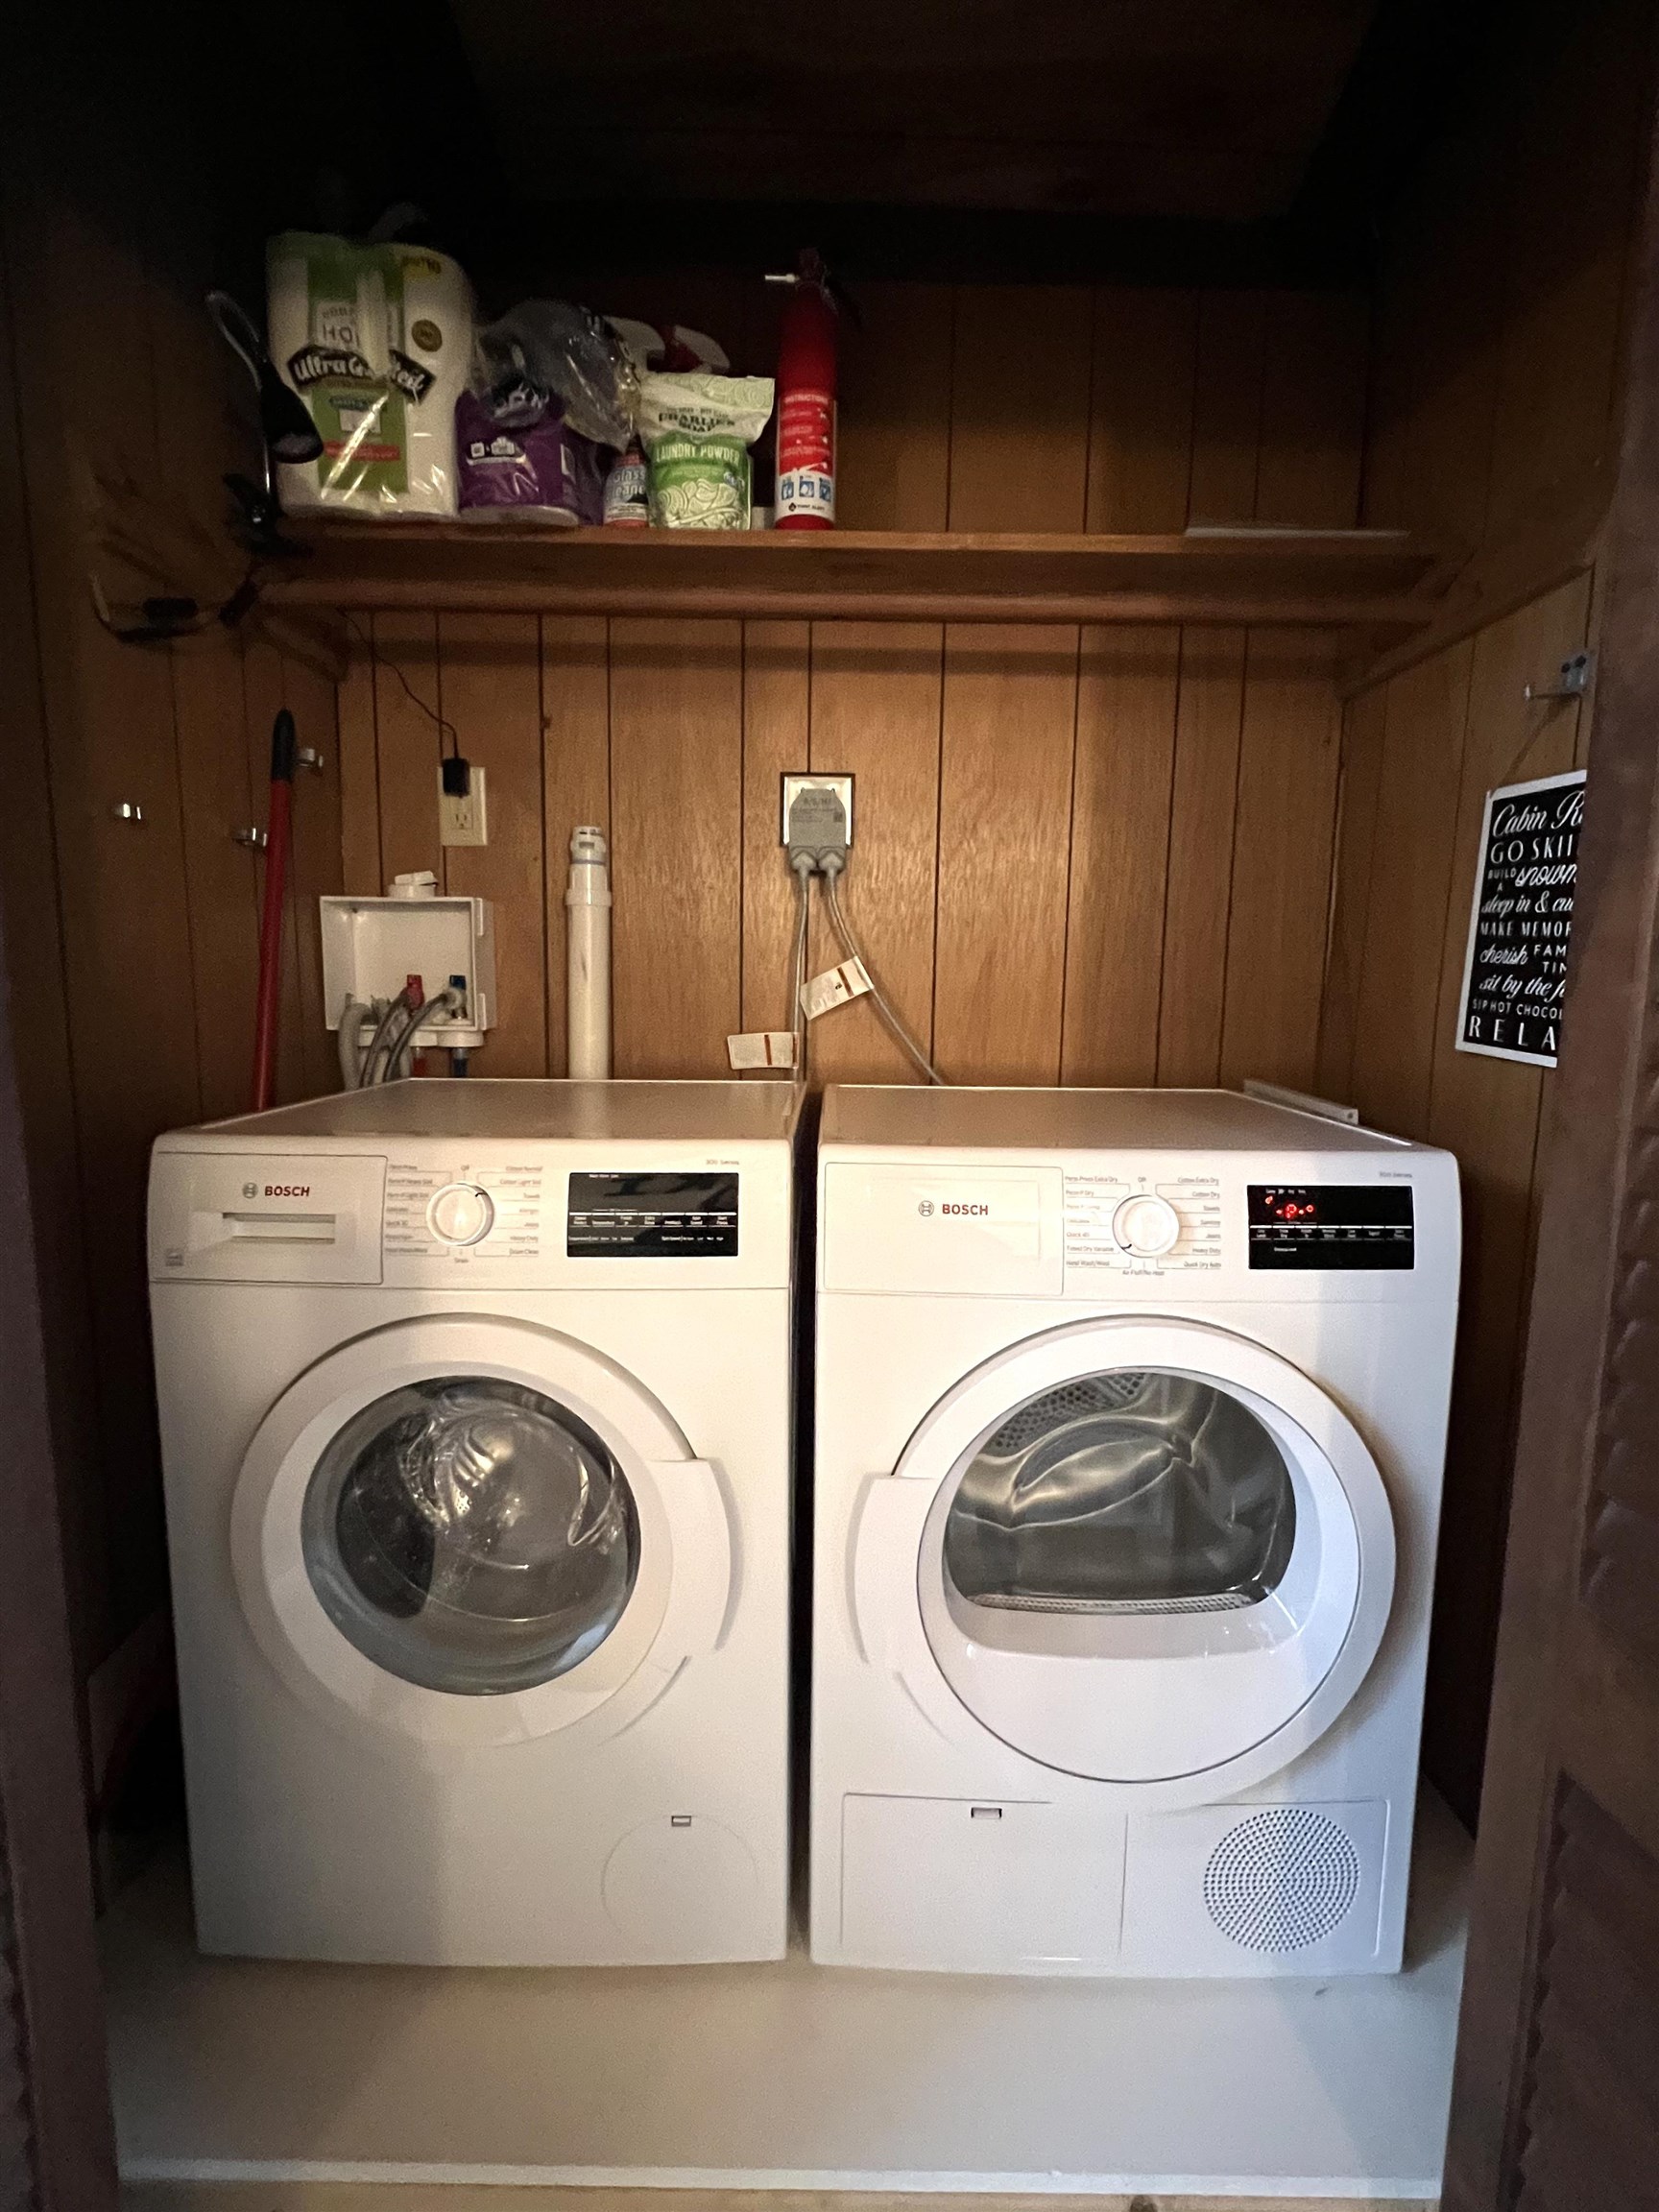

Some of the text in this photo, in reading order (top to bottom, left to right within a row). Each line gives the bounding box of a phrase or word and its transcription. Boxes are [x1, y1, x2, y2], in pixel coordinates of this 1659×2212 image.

[656, 443, 740, 468] LAUNDRY POWDER
[613, 469, 646, 483] Glass
[1492, 790, 1585, 838] Cabin R
[1490, 840, 1524, 864] GO
[1487, 867, 1517, 879] BUILD
[1497, 881, 1503, 892] A
[1481, 893, 1514, 919] sleep
[1515, 893, 1531, 914] in
[1534, 890, 1551, 913] &
[1479, 920, 1514, 937] MAKE
[1479, 943, 1567, 966] cherish FAM
[1479, 973, 1503, 992] sit
[1502, 974, 1523, 999] by
[1524, 975, 1552, 997] the
[1472, 998, 1489, 1010] SIP
[1489, 1001, 1512, 1015] HOT
[1469, 1015, 1556, 1051] RELA
[264, 1185, 311, 1198] BOSCH
[942, 1203, 989, 1216] BOSCH
